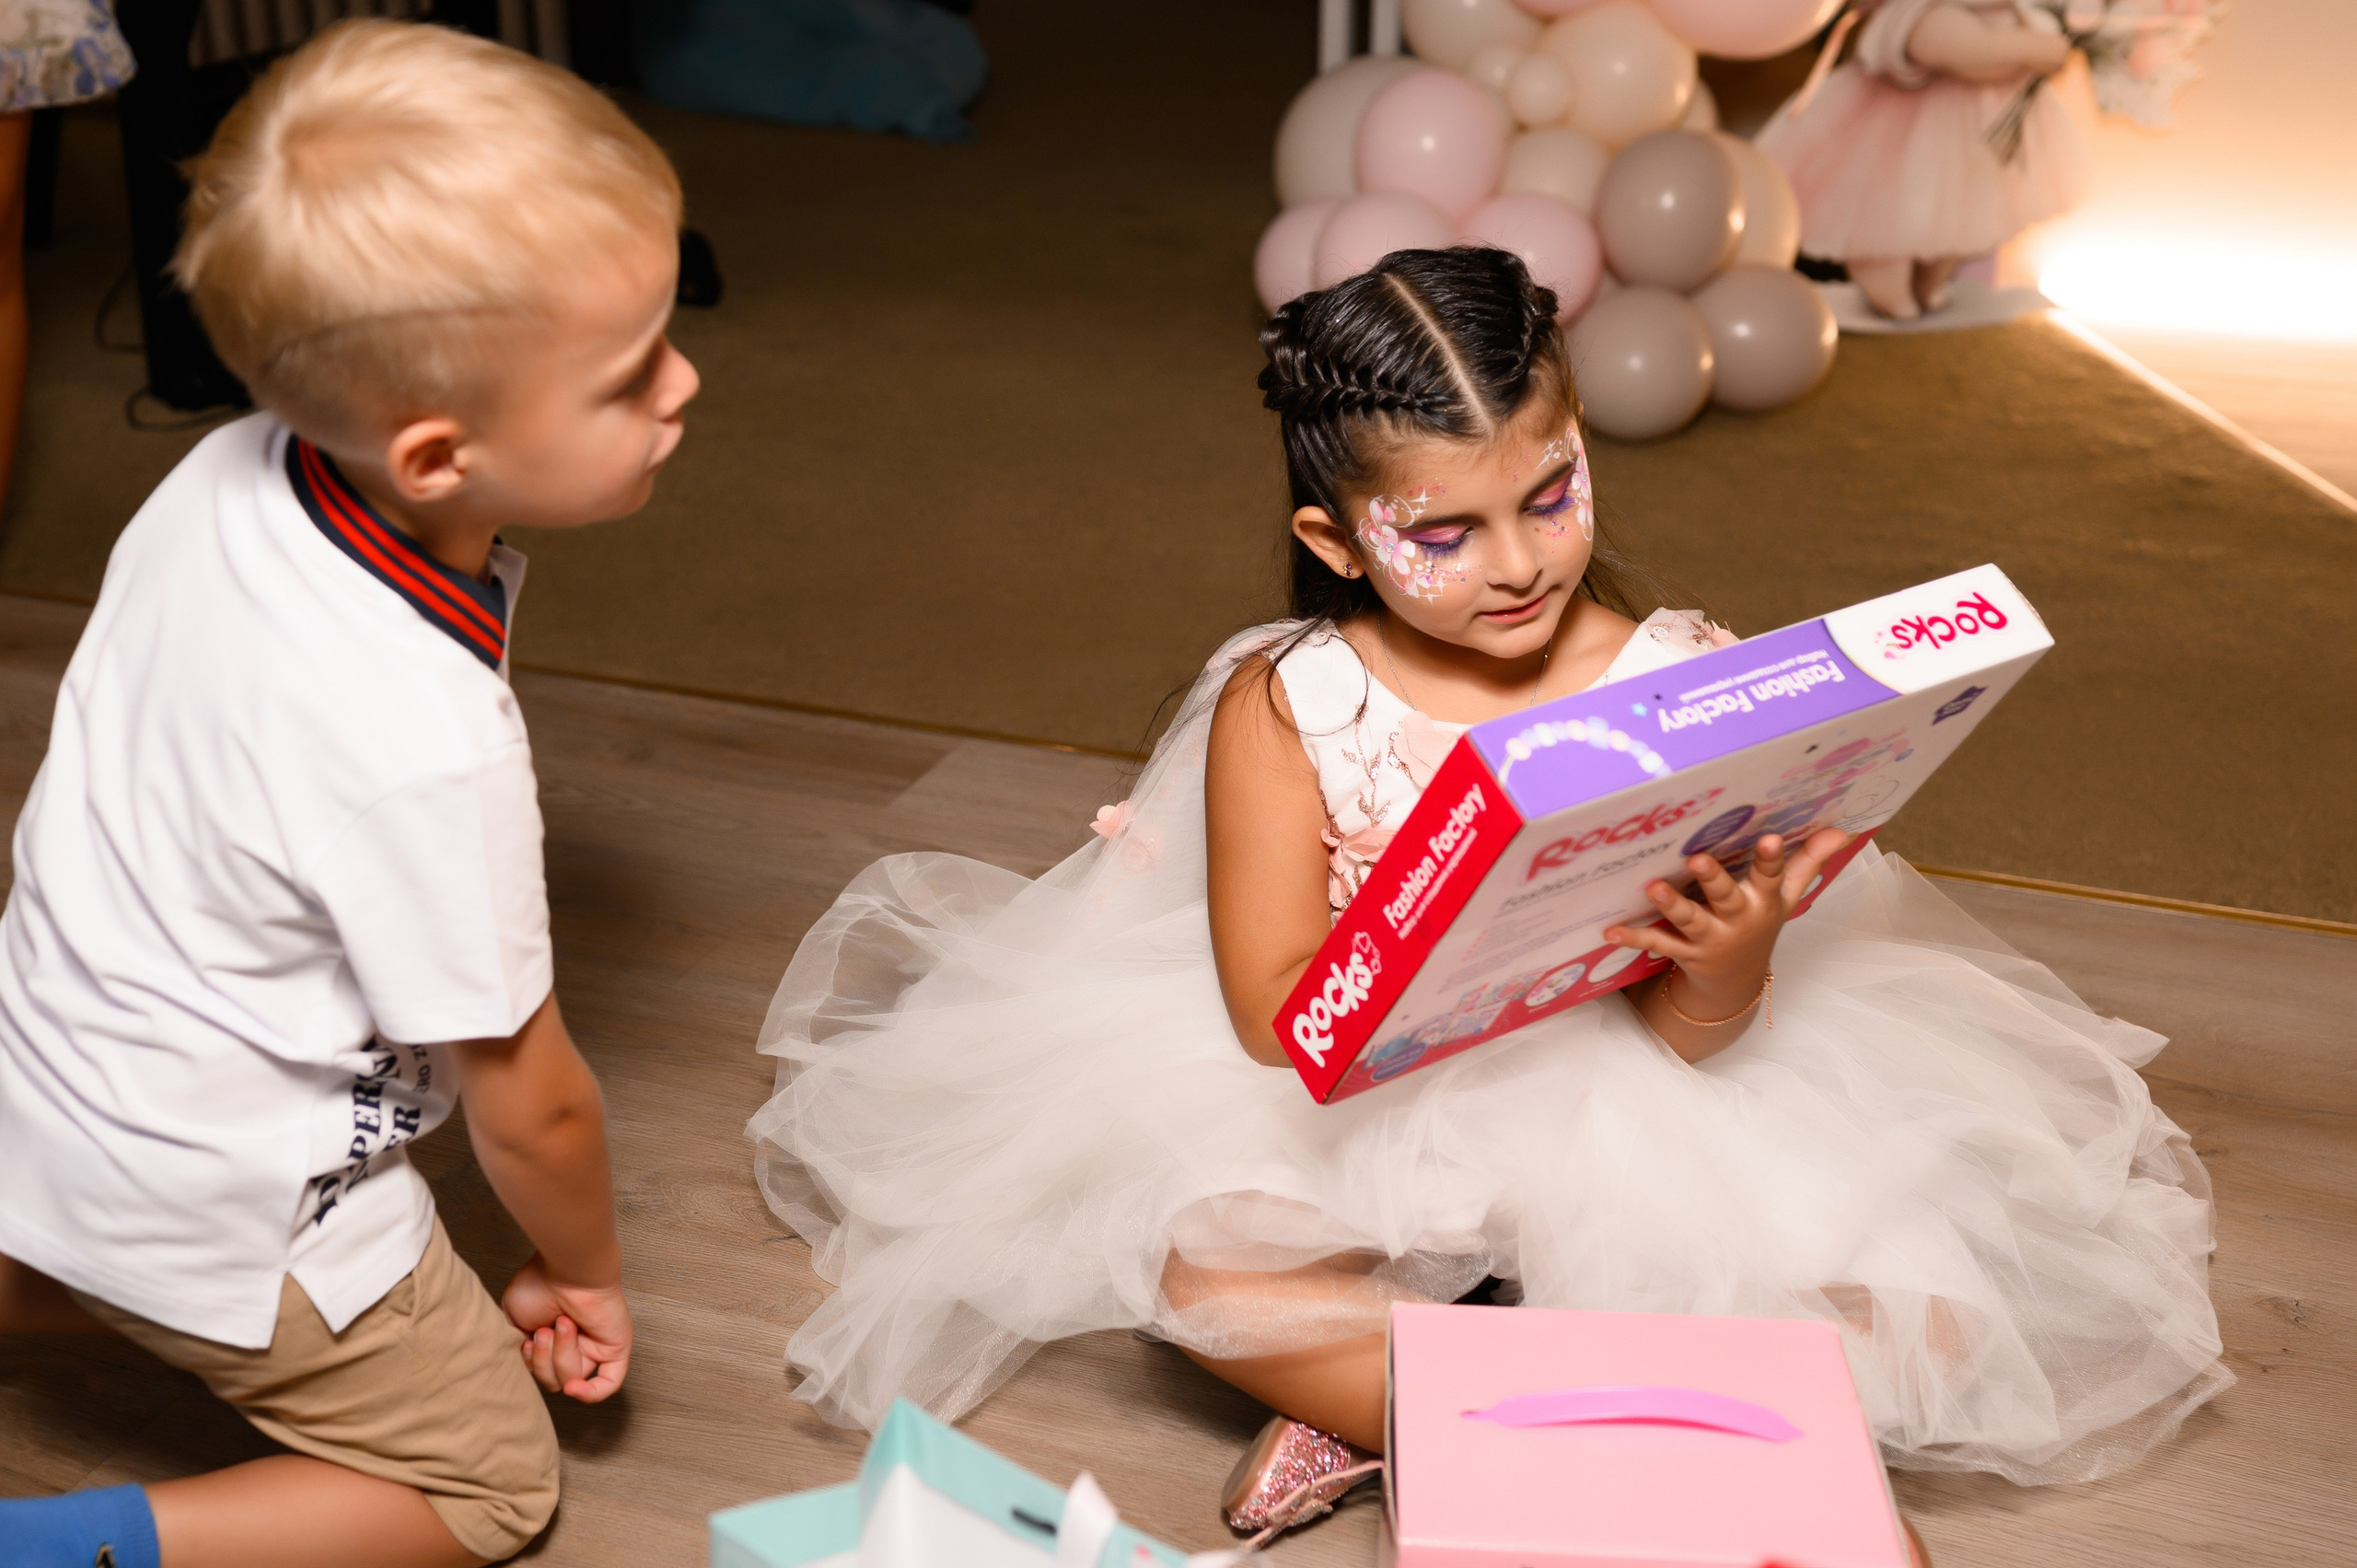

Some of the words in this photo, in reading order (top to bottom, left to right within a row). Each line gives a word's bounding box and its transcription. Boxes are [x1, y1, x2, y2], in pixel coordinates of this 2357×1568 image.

[1891, 591, 2008, 650] Rocks
[1657, 689, 1756, 734] Factory
[1748, 659, 1847, 702] Fashion
[1382, 858, 1438, 929] Fashion
[1428, 783, 1487, 862] Factory
[1525, 798, 1695, 882] Rocks
[1292, 952, 1374, 1069] Rocks
